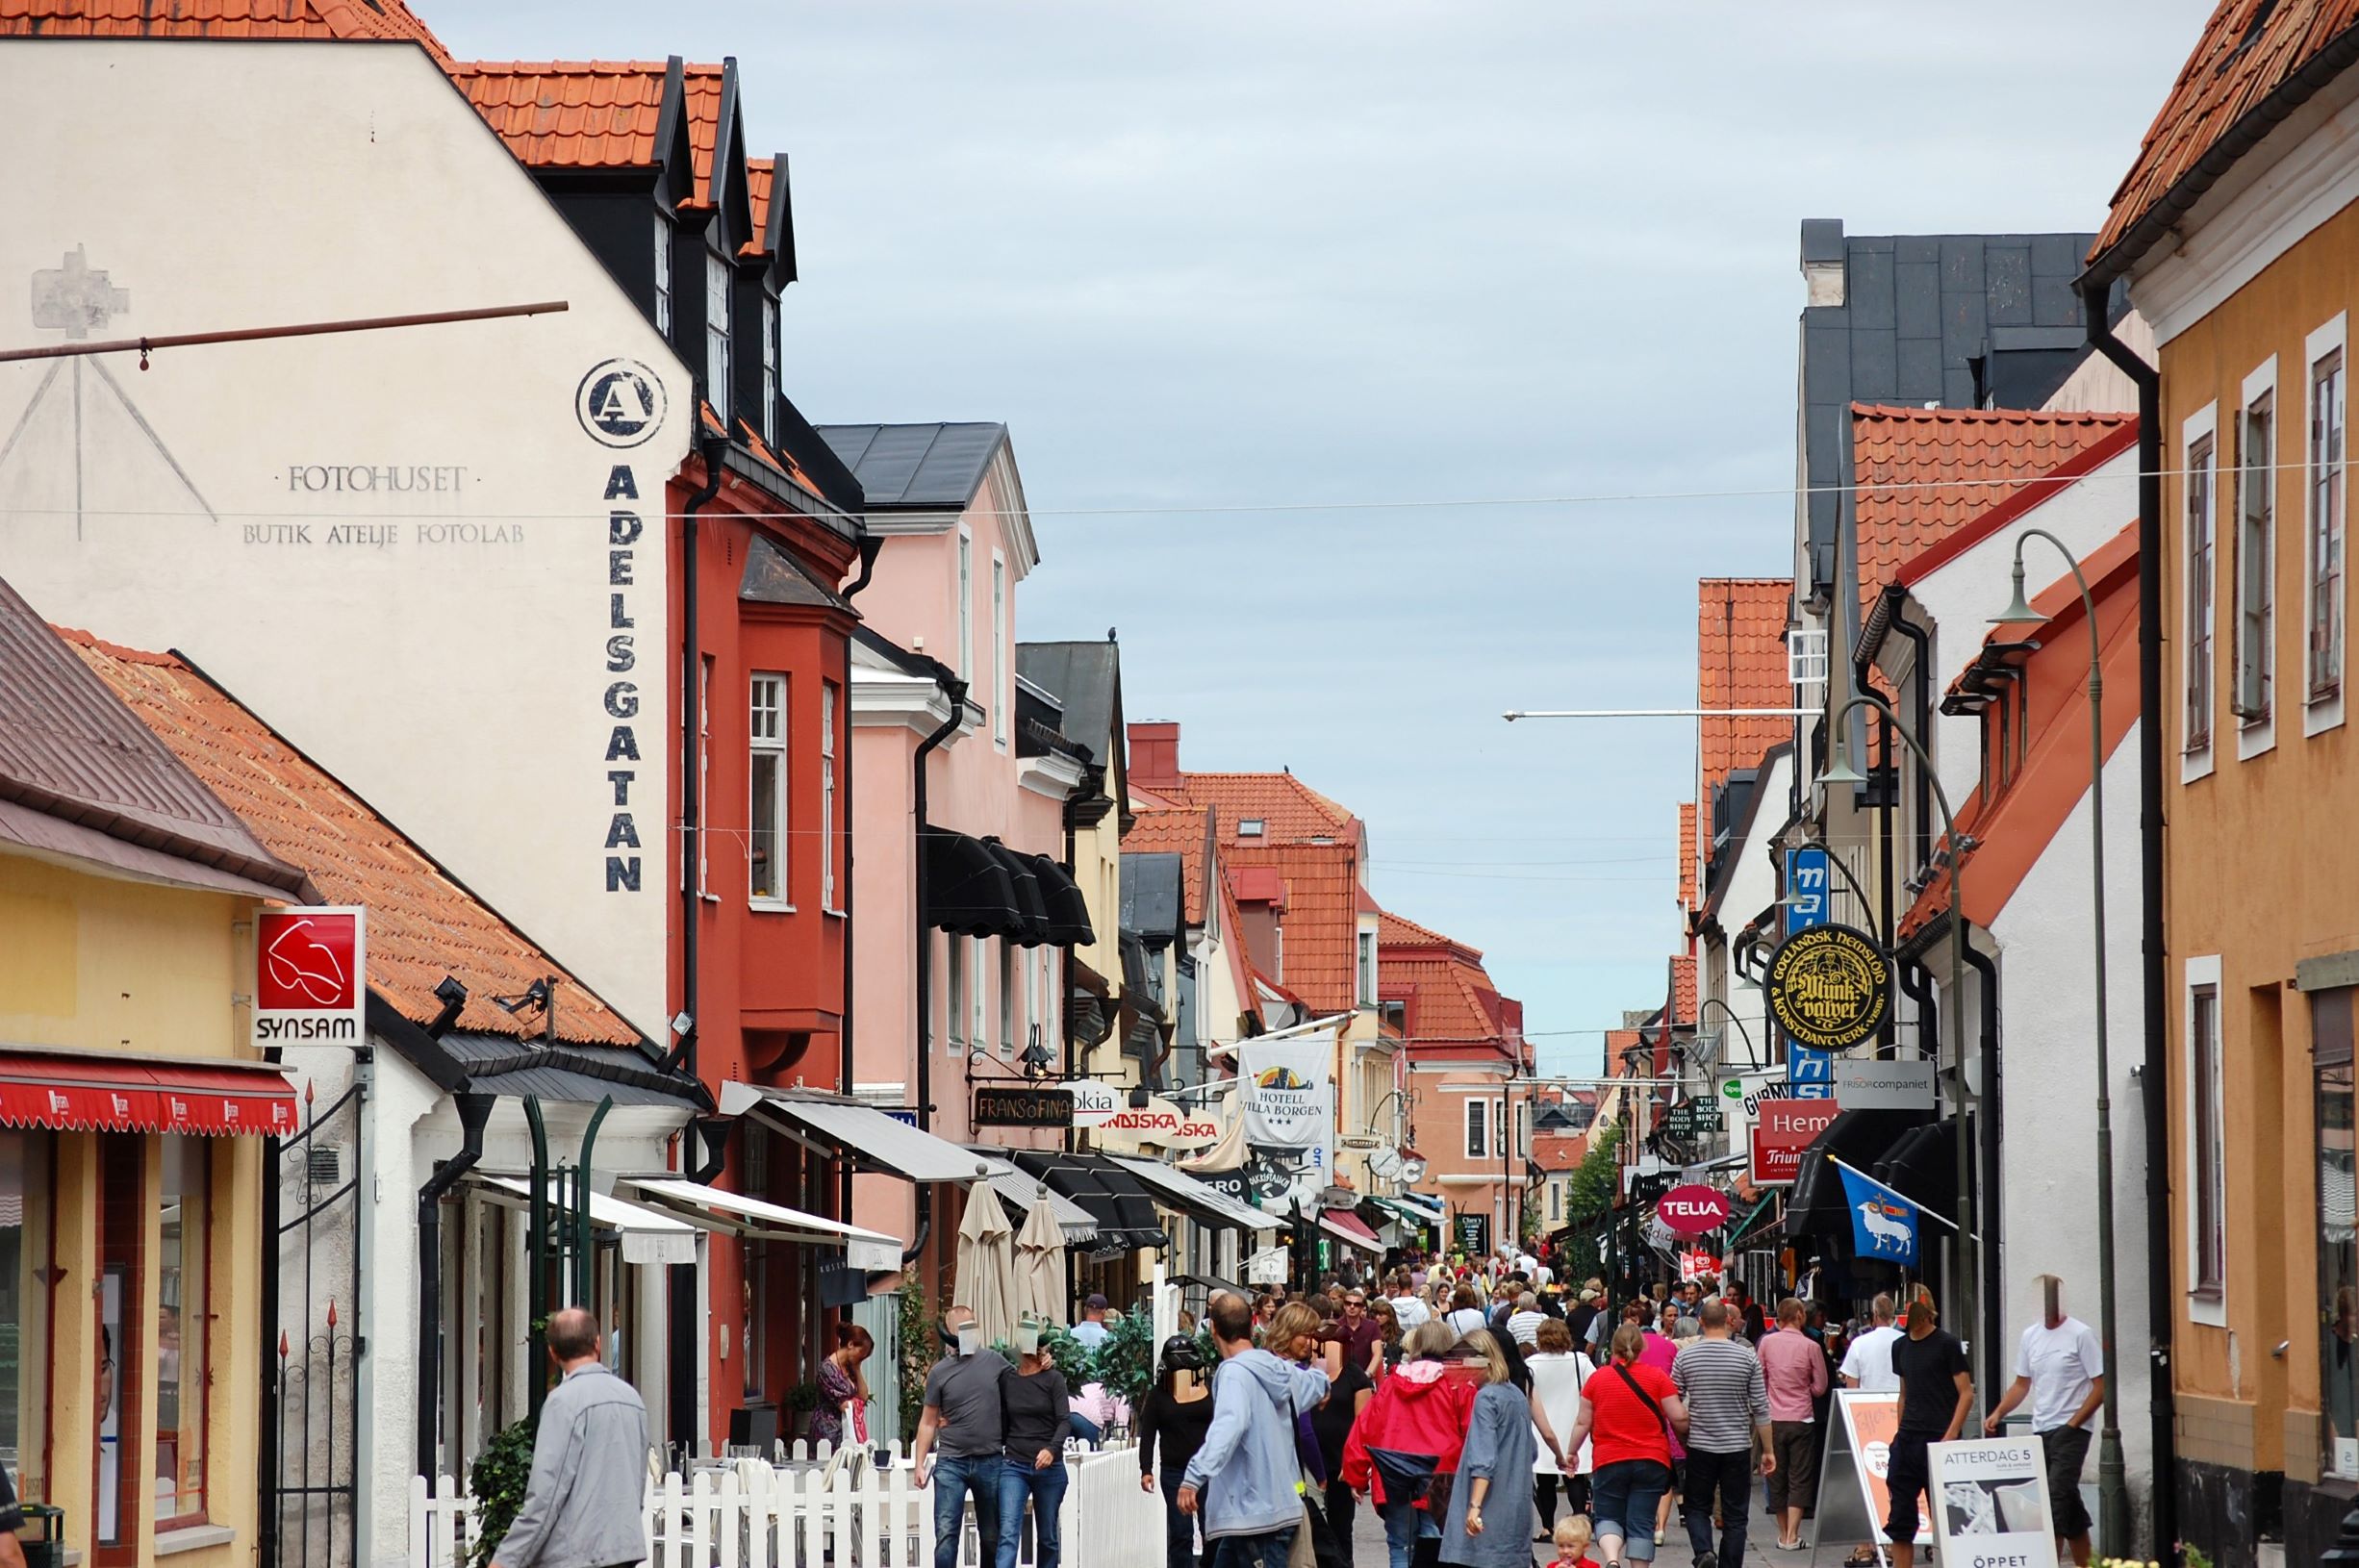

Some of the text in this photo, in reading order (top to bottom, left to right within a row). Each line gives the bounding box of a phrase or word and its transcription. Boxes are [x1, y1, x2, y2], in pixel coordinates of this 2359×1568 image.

[289, 466, 468, 493] FOTOHUSET
[242, 524, 525, 550] BUTIK ATELJE FOTOLAB
[602, 465, 644, 893] ADELSGATAN
[1773, 930, 1832, 980] GOTLÄNDSK
[256, 1018, 356, 1039] SYNSAM
[1074, 1090, 1113, 1110] okia
[1259, 1092, 1305, 1104] HOTELL
[1274, 1104, 1323, 1116] BORGEN
[1773, 1113, 1838, 1133] Hem
[1663, 1201, 1723, 1216] TELIA
[1944, 1449, 2031, 1465] ATTERDAG 5
[1973, 1555, 2027, 1568] ÖPPET
